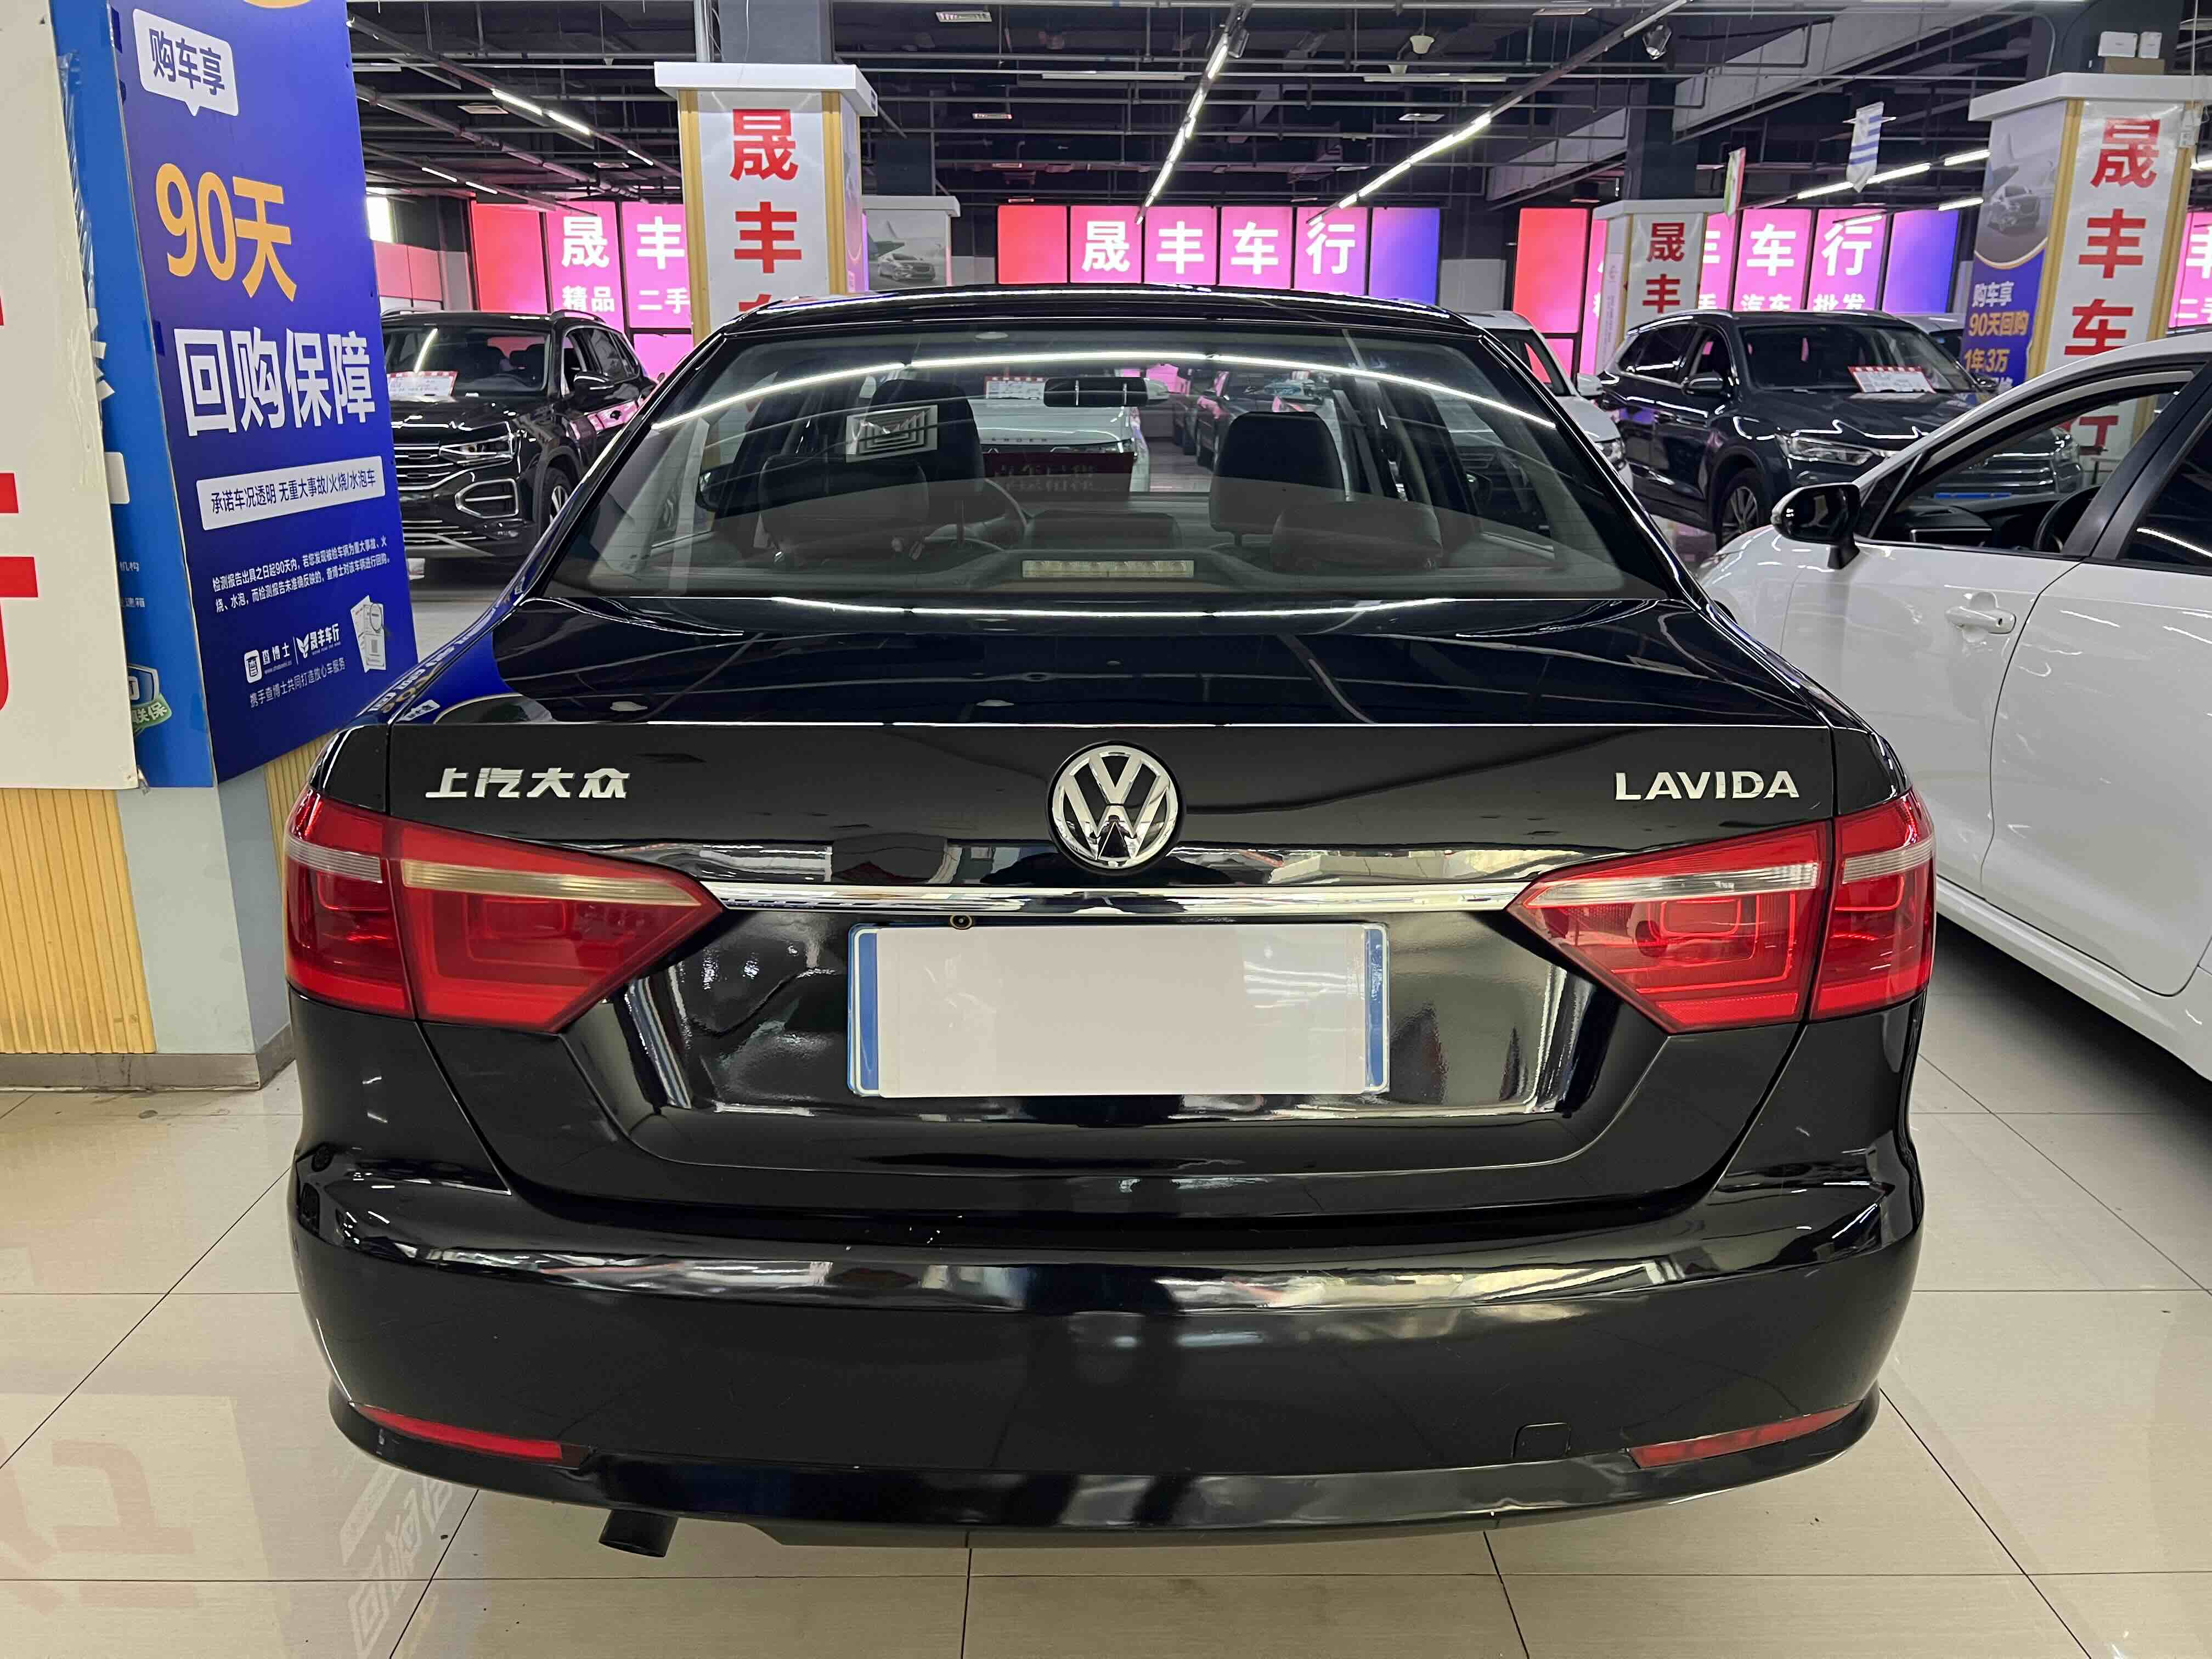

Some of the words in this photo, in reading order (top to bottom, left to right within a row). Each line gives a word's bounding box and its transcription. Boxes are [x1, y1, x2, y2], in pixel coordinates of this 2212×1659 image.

[149, 30, 225, 95] 购车享
[156, 163, 297, 302] 90天
[730, 109, 802, 313] 晟丰
[562, 216, 685, 269] 晟丰
[1082, 220, 1355, 274] 晟丰车行
[1643, 222, 1685, 313] 晟丰
[1972, 281, 2014, 307] 购车享
[174, 327, 376, 437] 回购保障
[211, 483, 276, 514] 承诺车况透明
[425, 767, 630, 799] 上汽大众
[1615, 770, 1799, 800] LAVIDA
